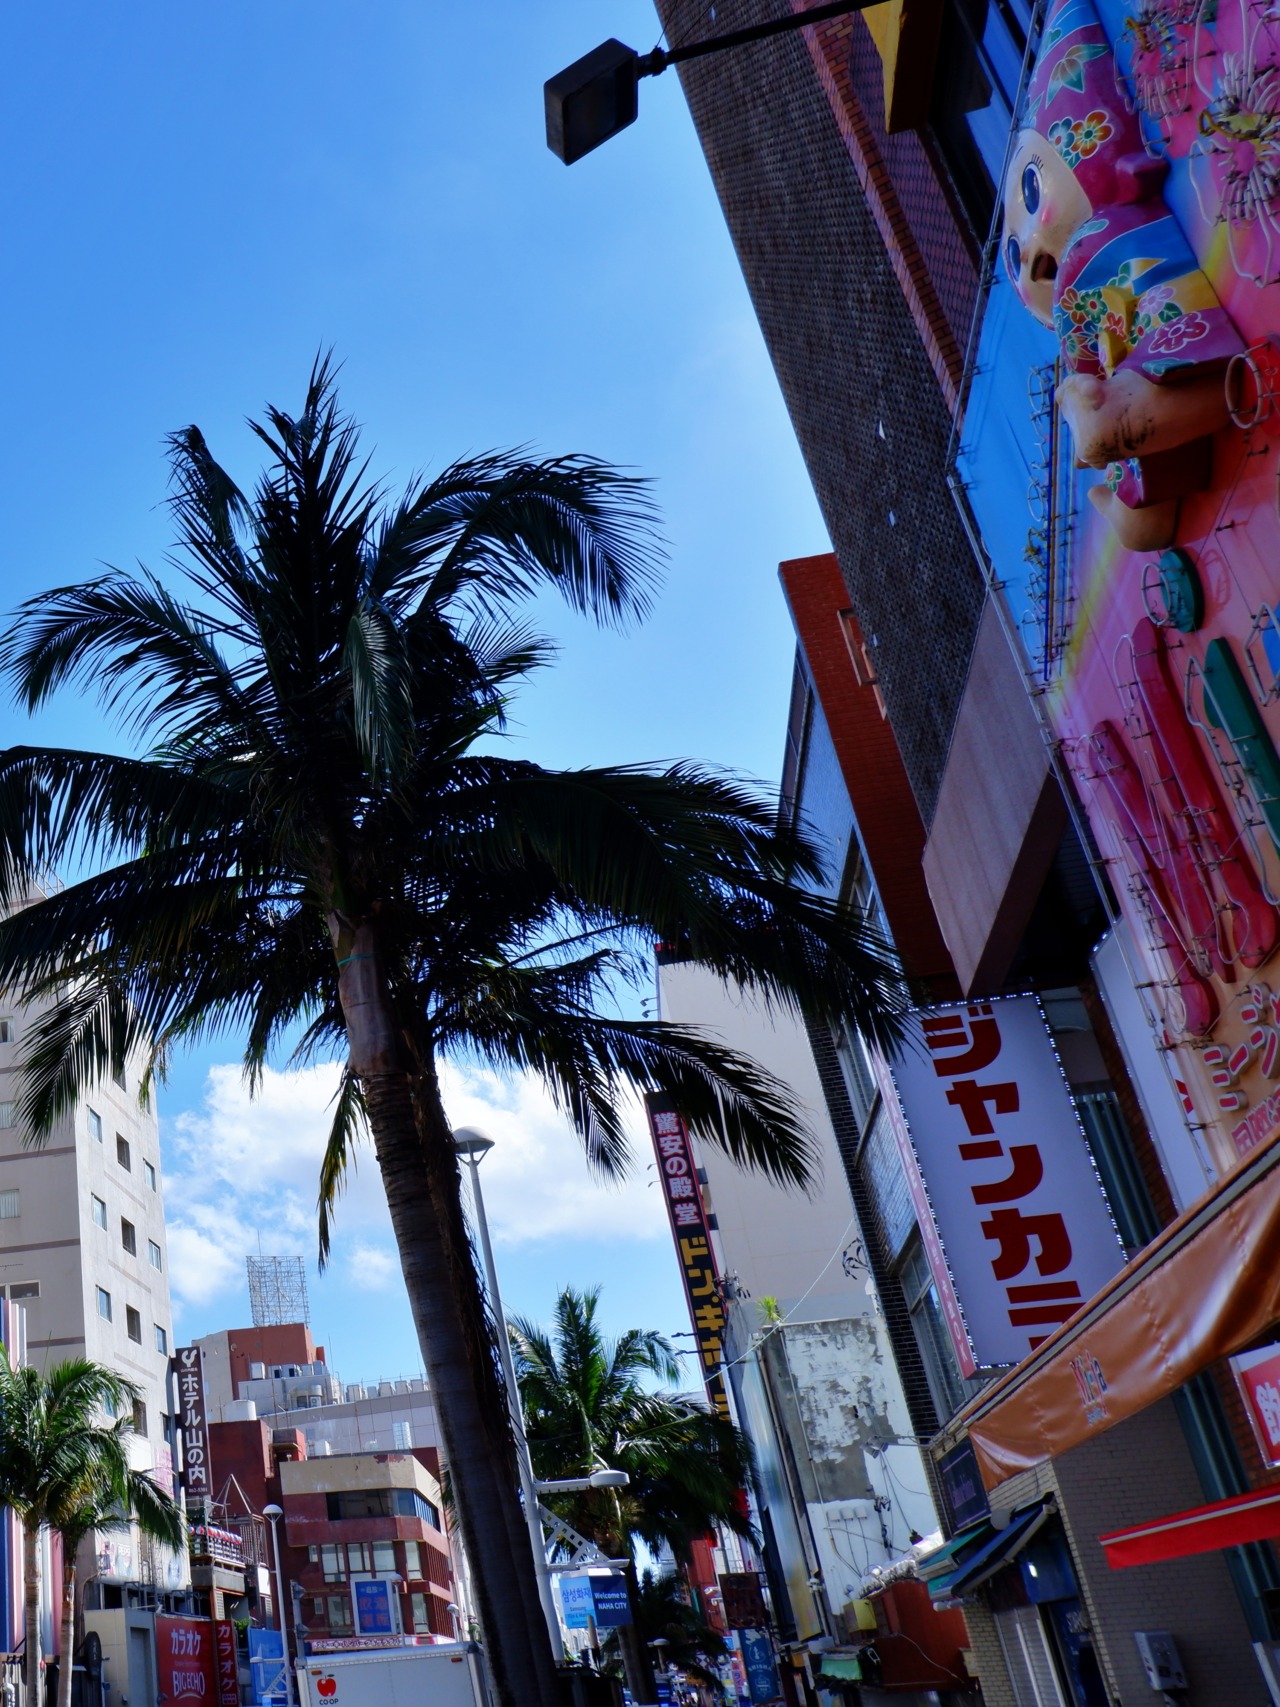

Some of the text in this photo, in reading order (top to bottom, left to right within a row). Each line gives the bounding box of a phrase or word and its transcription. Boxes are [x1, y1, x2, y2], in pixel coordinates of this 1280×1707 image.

[653, 1111, 702, 1227] 驚安の殿堂
[876, 1054, 918, 1189] ARAOKE
[181, 1373, 207, 1486] ホテル山の内
[171, 1627, 202, 1656] カラオケ
[218, 1624, 235, 1692] カラオケ
